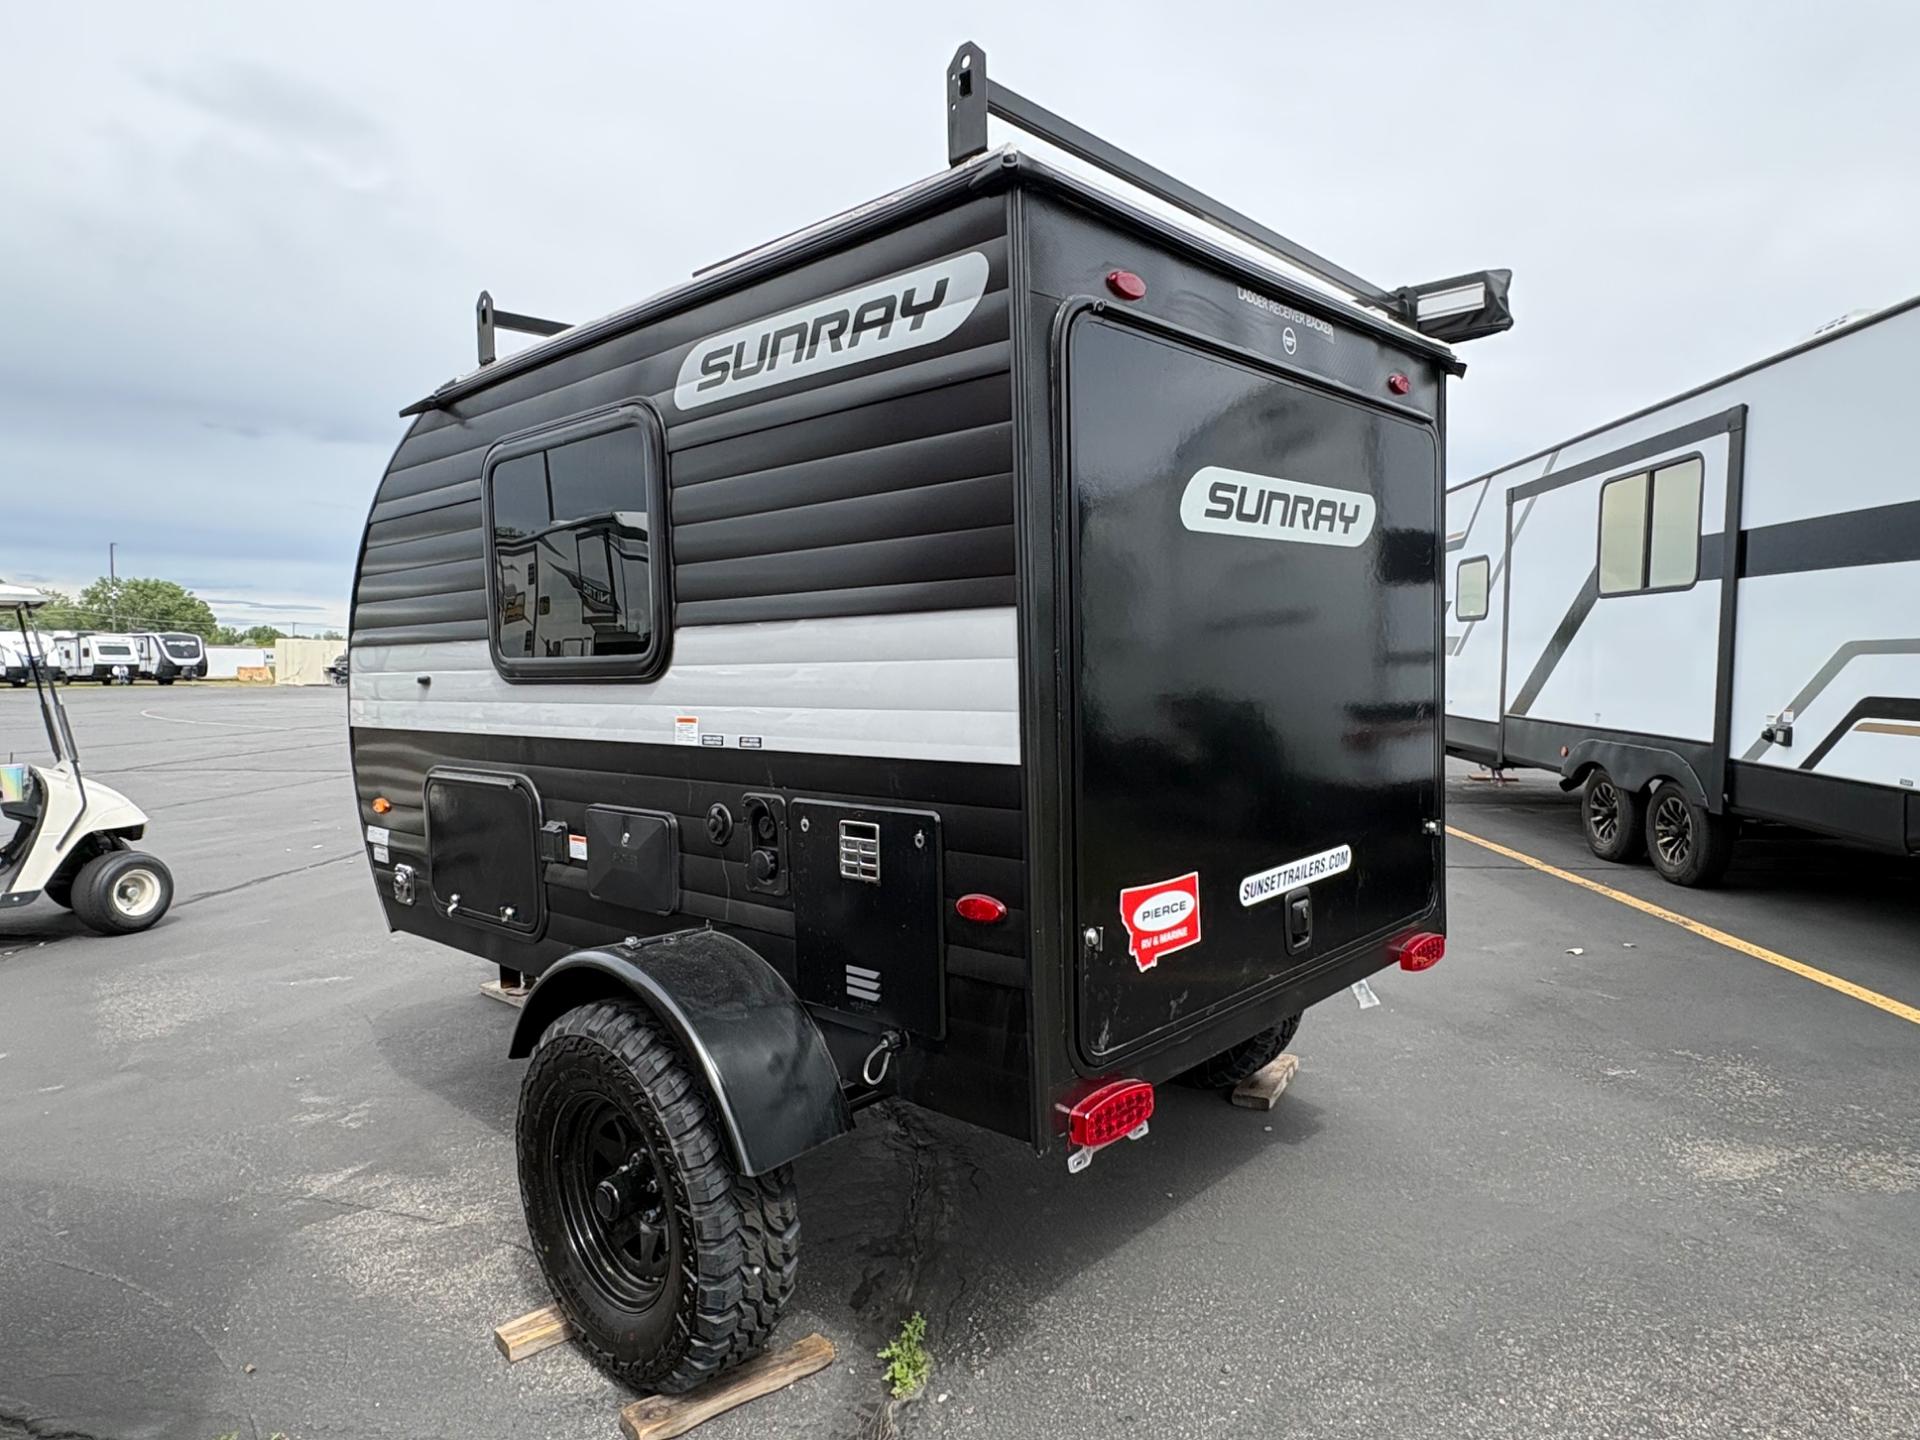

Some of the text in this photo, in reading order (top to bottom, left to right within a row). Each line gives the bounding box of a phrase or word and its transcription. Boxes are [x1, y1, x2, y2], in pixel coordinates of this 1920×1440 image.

[697, 277, 950, 393] SUNRAY
[1237, 286, 1334, 337] LADDER RECEIVER BACKER
[1204, 481, 1360, 534] SUNRAY
[1243, 849, 1349, 901] SUNSETTRAILERS.COM
[1142, 900, 1187, 922] PIERCE
[1141, 936, 1152, 950] RV
[1160, 926, 1188, 944] MARINE
